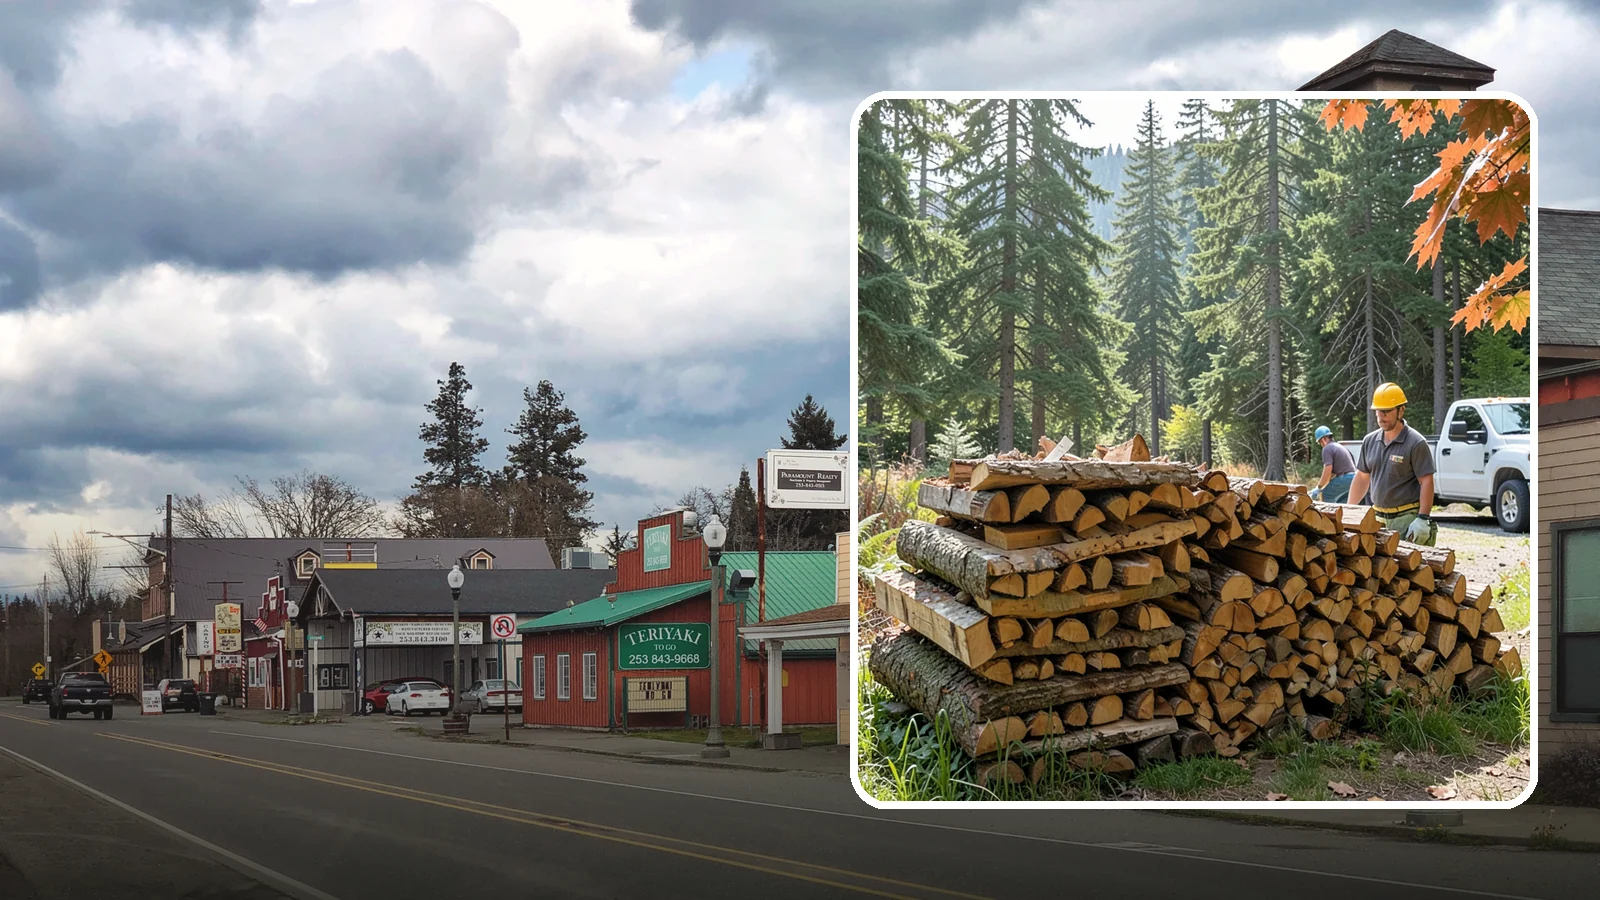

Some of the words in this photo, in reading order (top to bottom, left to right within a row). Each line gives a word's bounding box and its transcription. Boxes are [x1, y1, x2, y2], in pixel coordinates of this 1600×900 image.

[781, 471, 815, 479] PARAMOUNT
[817, 472, 839, 480] REALTY
[229, 606, 240, 614] Roy
[625, 627, 702, 646] TERIYAKI
[629, 654, 648, 664] 253
[651, 653, 700, 664] 843-9668
[639, 681, 673, 690] TERIYAKI
